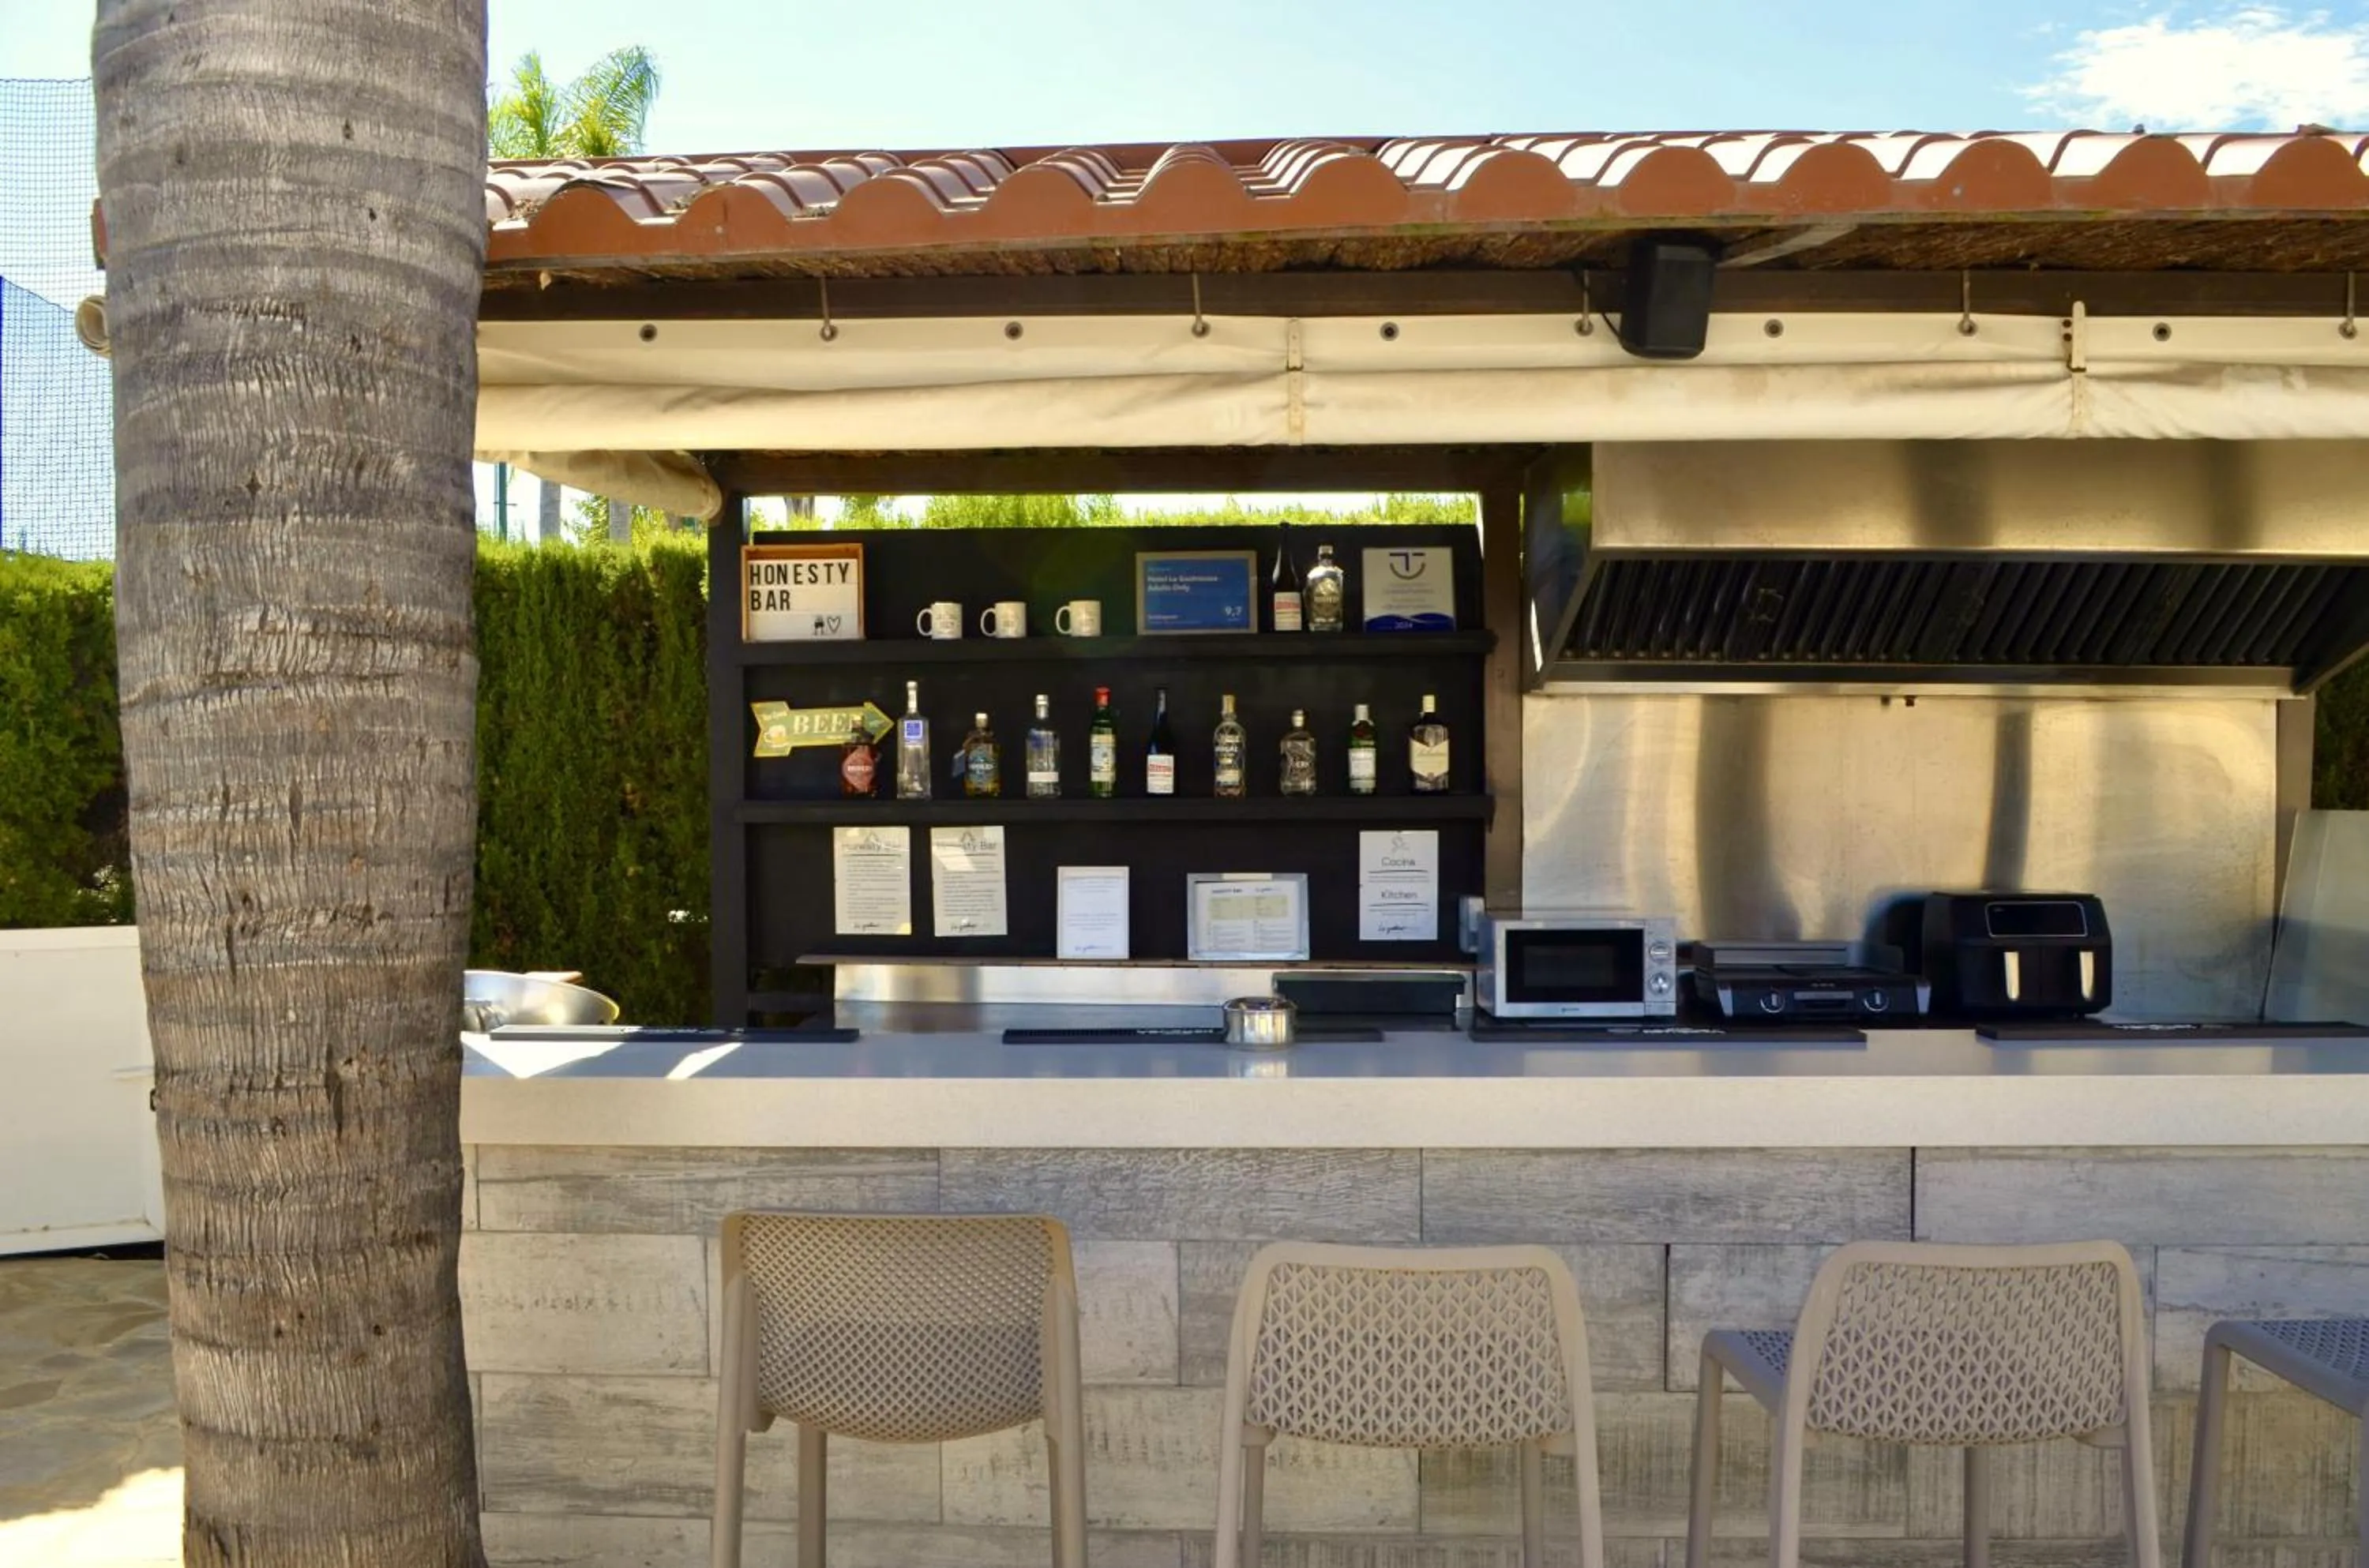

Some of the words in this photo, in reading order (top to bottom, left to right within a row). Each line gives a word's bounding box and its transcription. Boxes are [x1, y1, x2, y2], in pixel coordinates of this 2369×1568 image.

[749, 562, 849, 585] HONESTY
[750, 590, 790, 611] BAR
[1381, 889, 1418, 898] Kitchen
